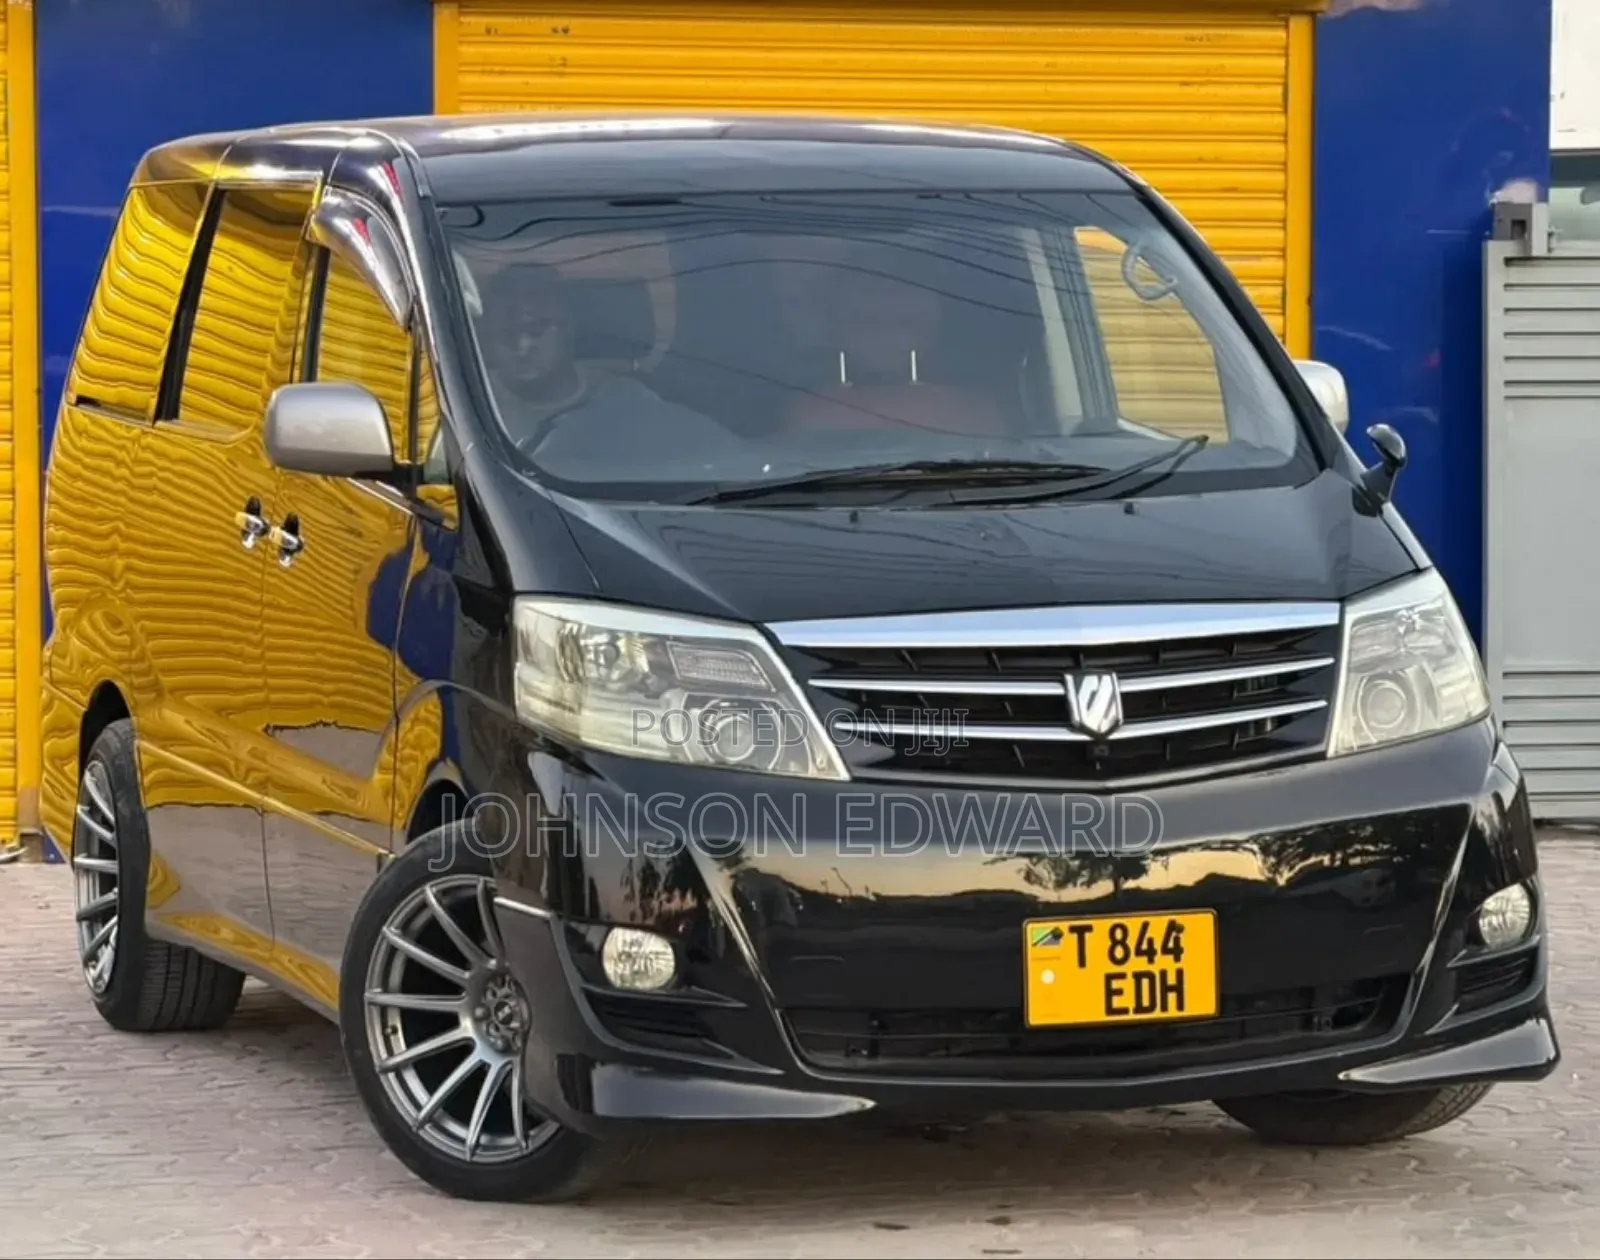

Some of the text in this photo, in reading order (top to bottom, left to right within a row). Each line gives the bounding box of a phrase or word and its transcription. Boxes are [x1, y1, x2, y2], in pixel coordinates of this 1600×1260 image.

[1068, 919, 1184, 968] T 844
[1104, 967, 1184, 1016] EDH
